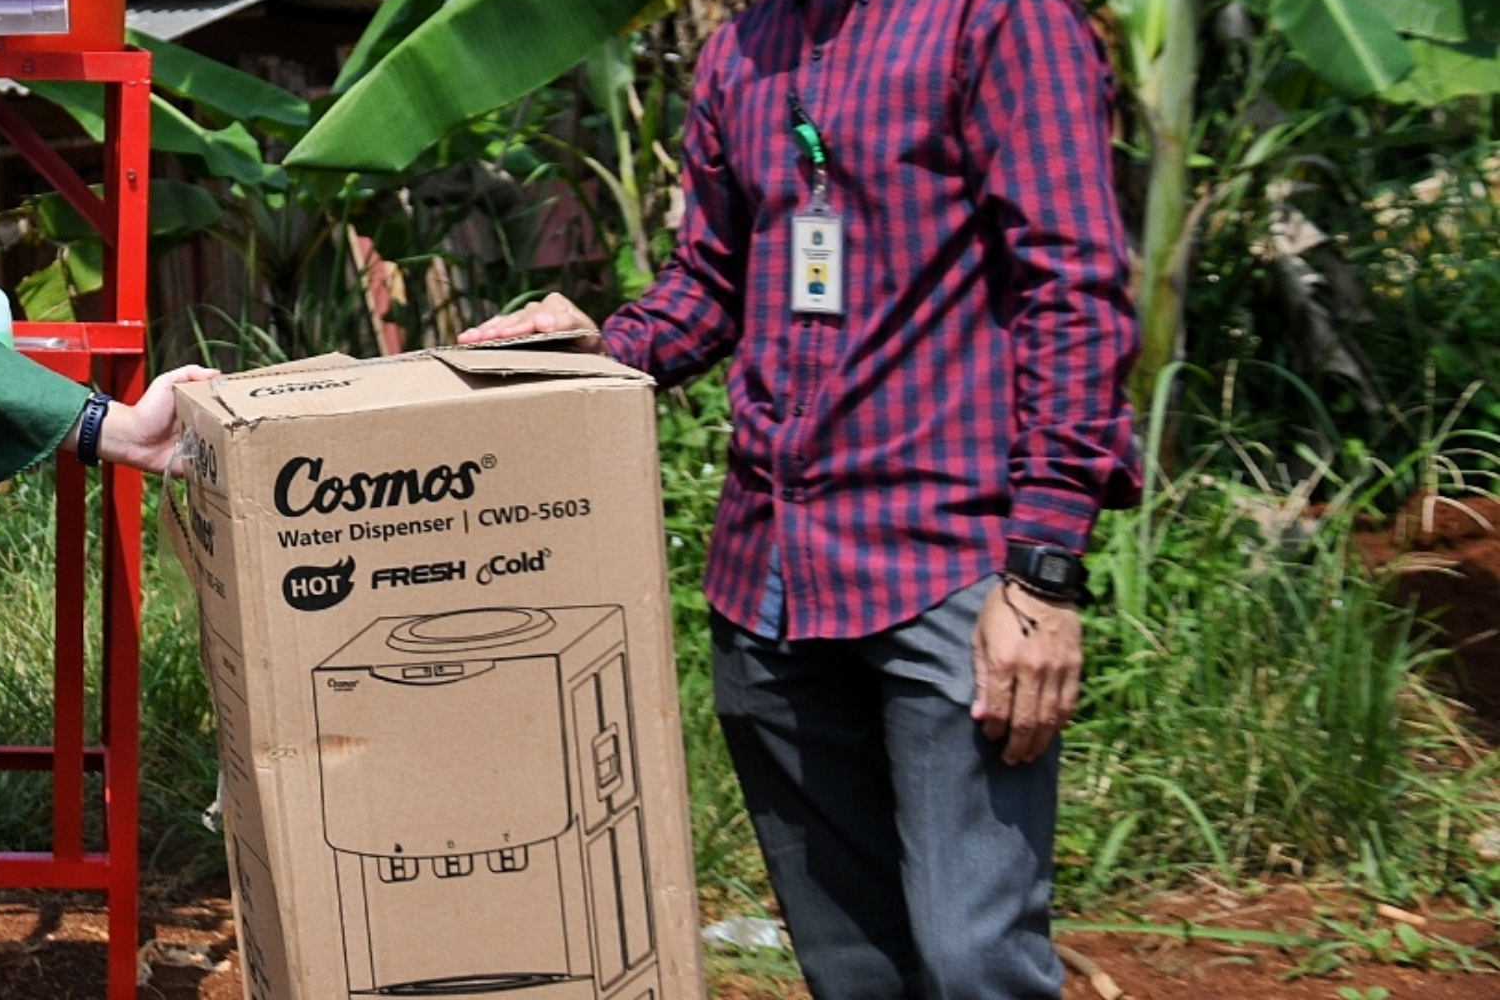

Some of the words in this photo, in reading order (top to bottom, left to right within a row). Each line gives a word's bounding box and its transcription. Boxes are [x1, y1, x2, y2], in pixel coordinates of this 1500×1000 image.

[277, 528, 343, 548] Water
[349, 515, 454, 542] Dispenser
[478, 498, 591, 527] CWD-5603
[290, 574, 342, 598] HOT
[371, 561, 466, 590] FRESH
[489, 550, 545, 577] Cold
